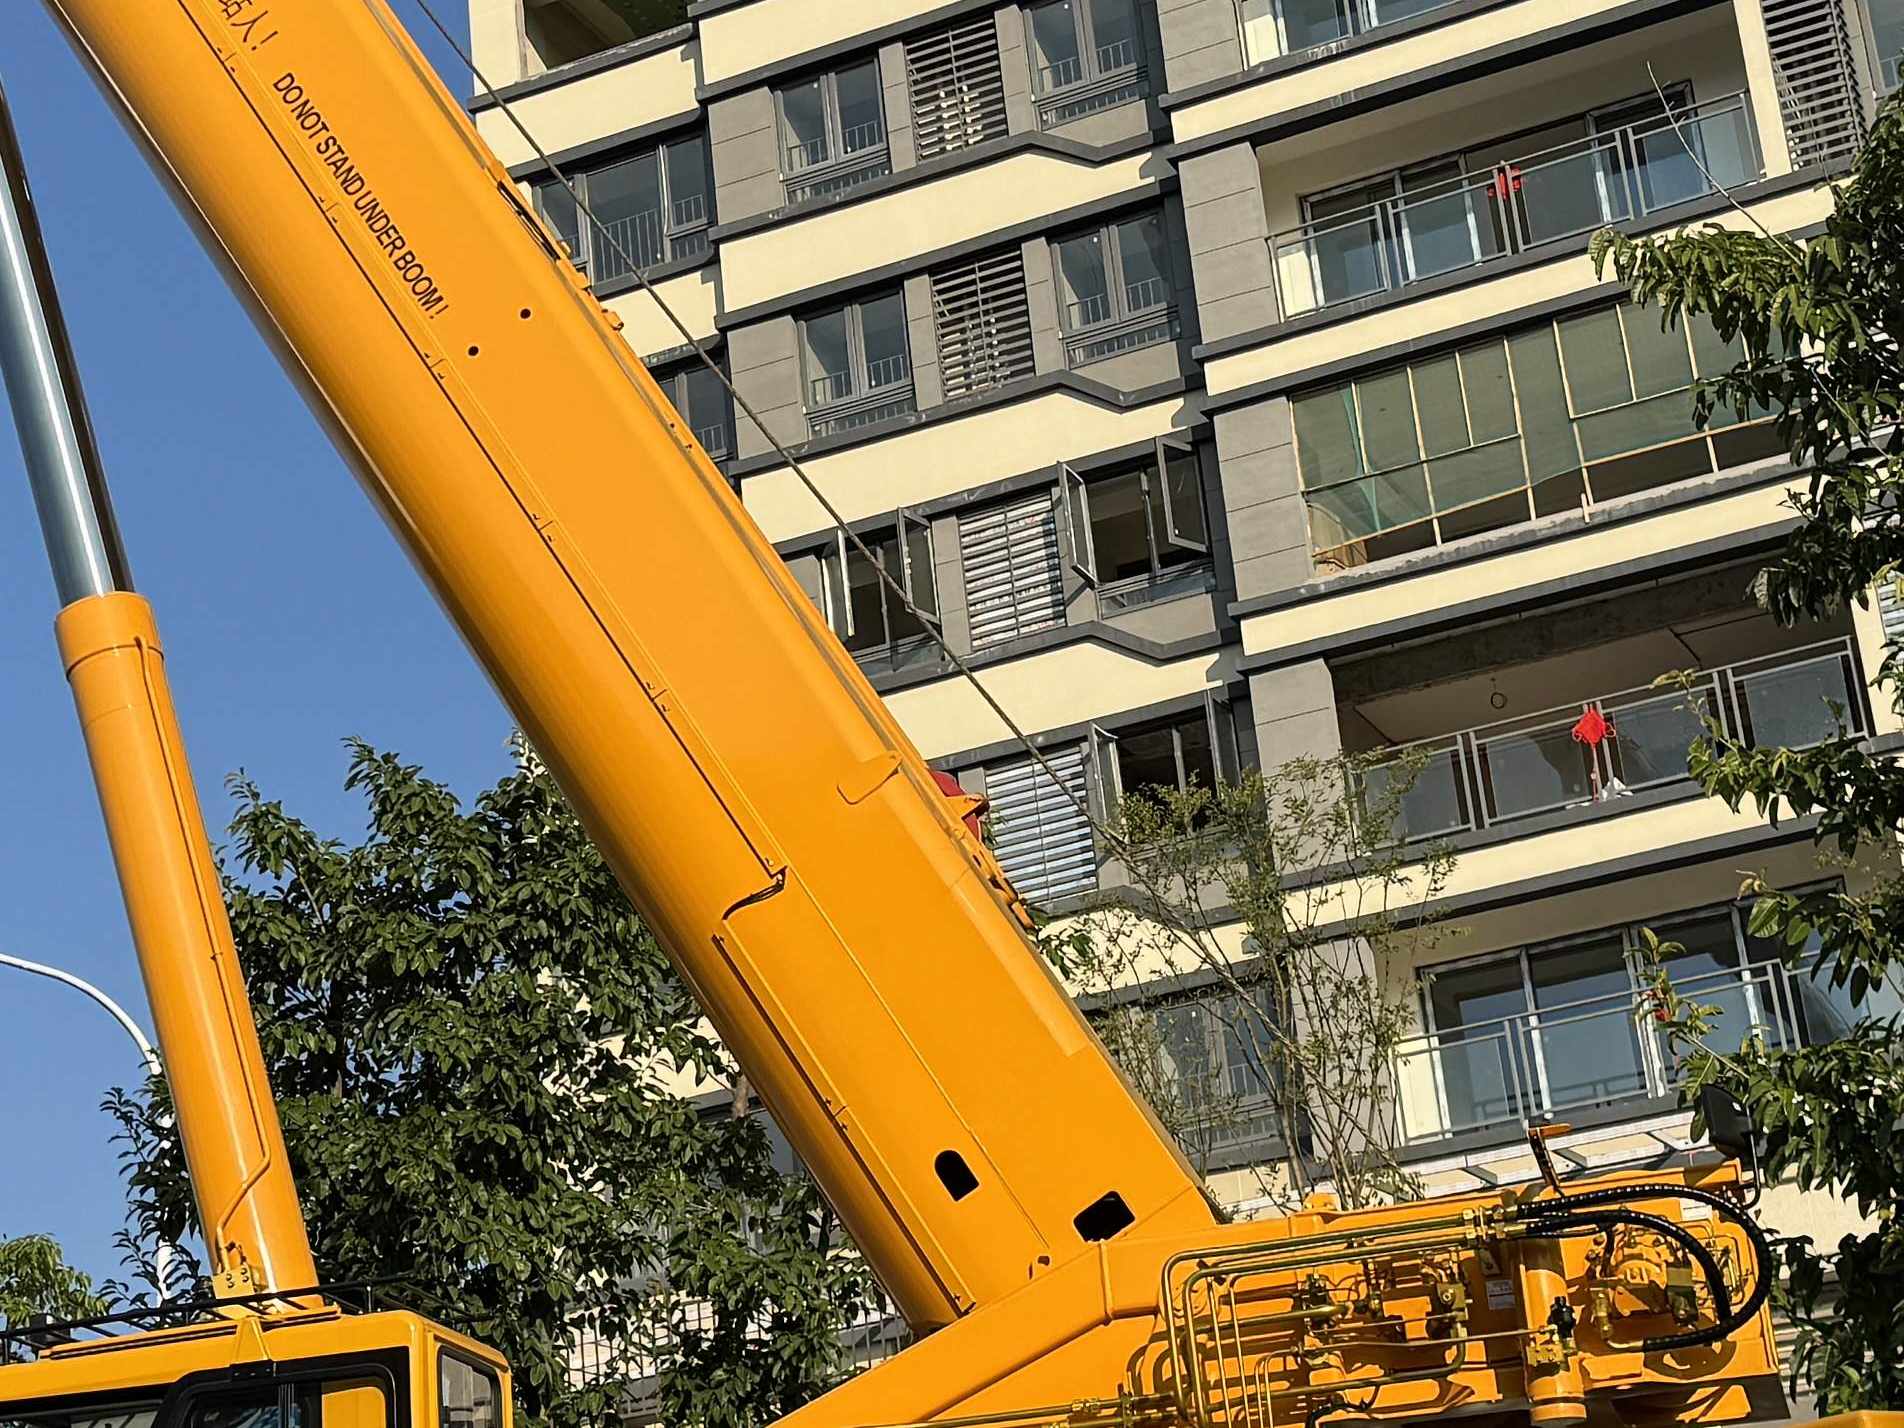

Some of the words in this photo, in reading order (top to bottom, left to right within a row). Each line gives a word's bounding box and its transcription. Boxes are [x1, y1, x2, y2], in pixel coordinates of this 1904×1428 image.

[272, 72, 303, 105] DO
[290, 98, 330, 139] NOT
[316, 135, 365, 196] STAND
[353, 190, 406, 258] UNDER
